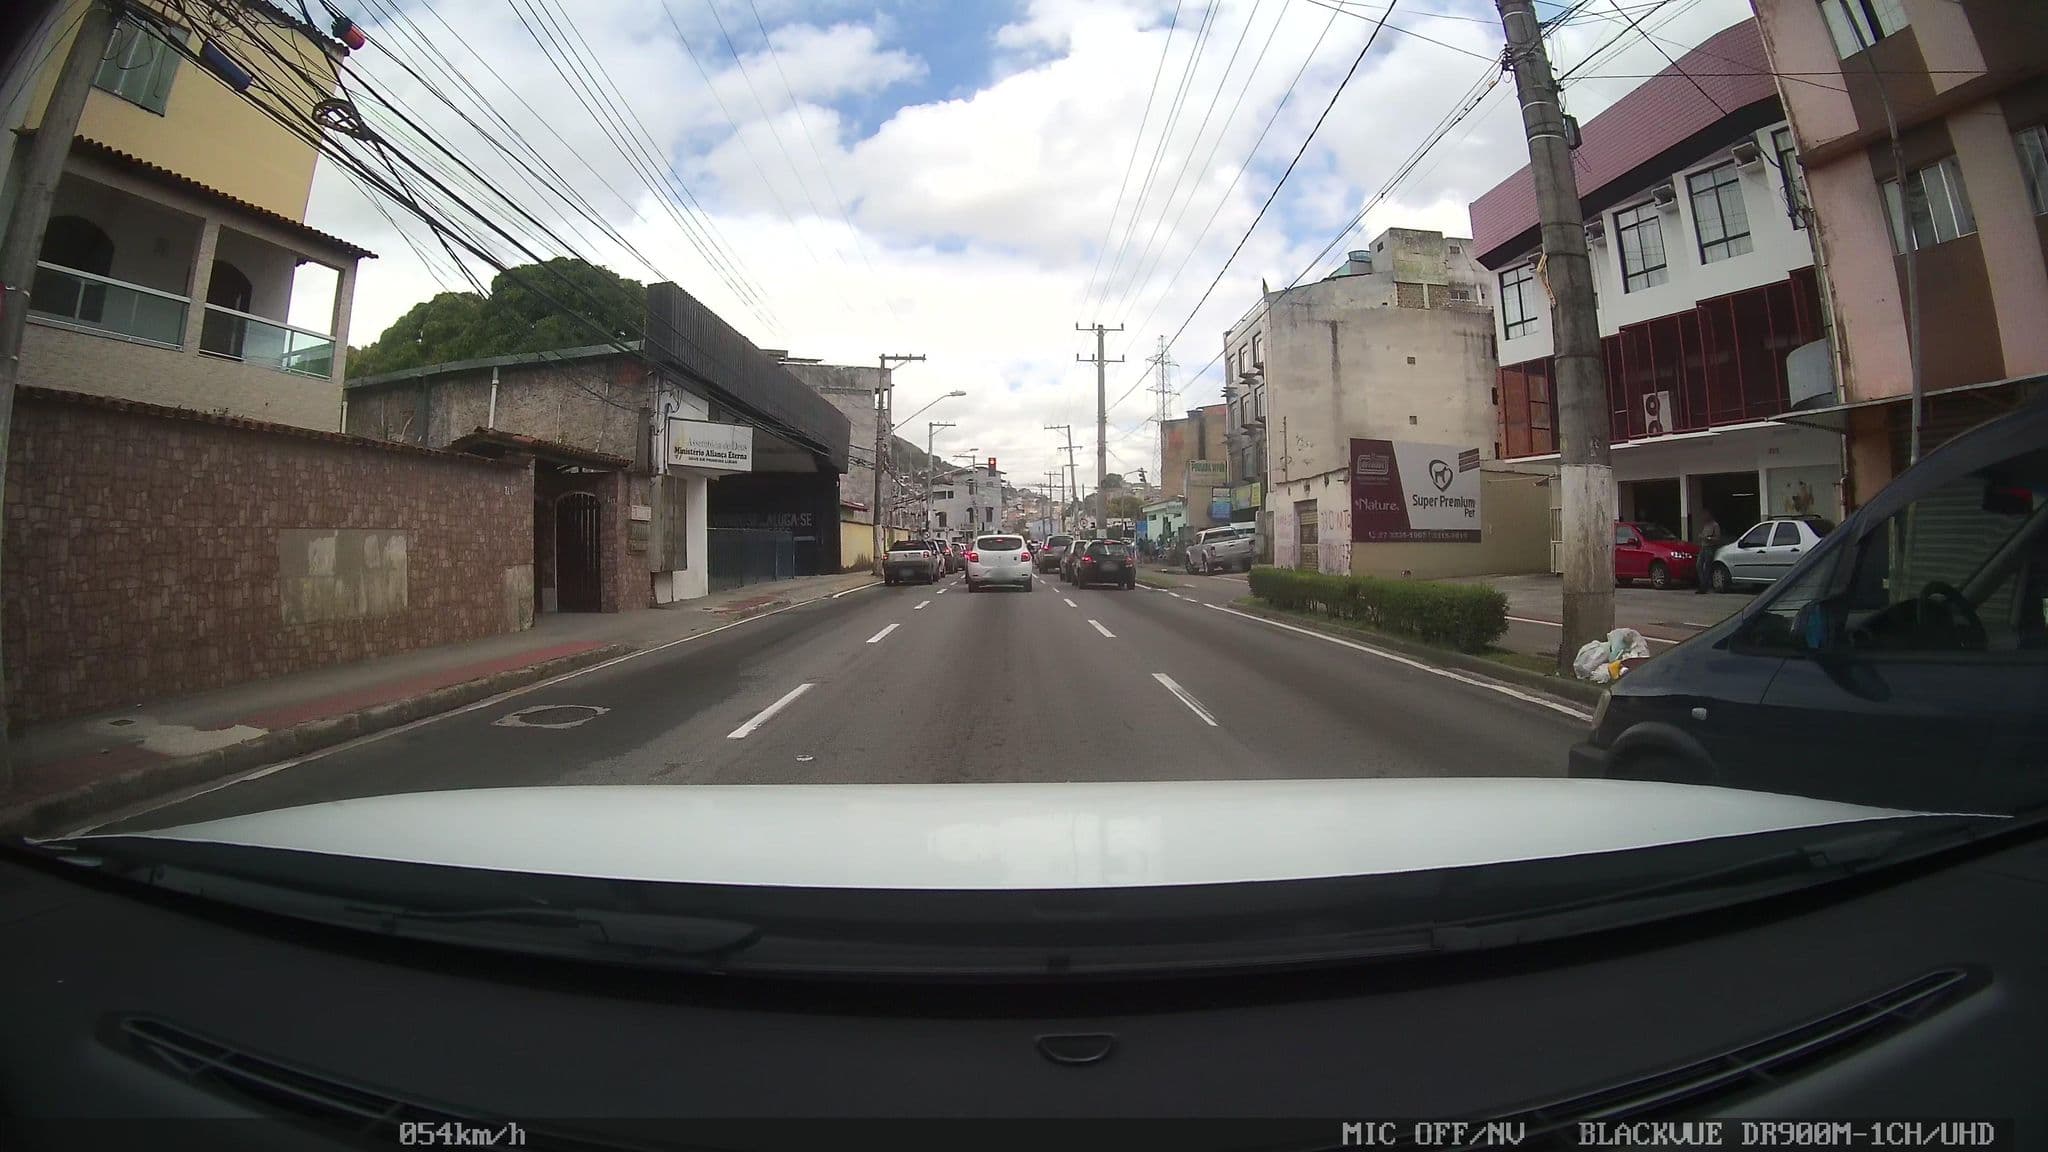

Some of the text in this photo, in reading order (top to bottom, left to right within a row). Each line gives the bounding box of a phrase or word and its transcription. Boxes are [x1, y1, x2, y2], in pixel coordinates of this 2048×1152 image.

[674, 446, 747, 460] Ministério Aliança Eterna
[1412, 494, 1475, 509] Super Premium
[1464, 508, 1475, 518] Pet
